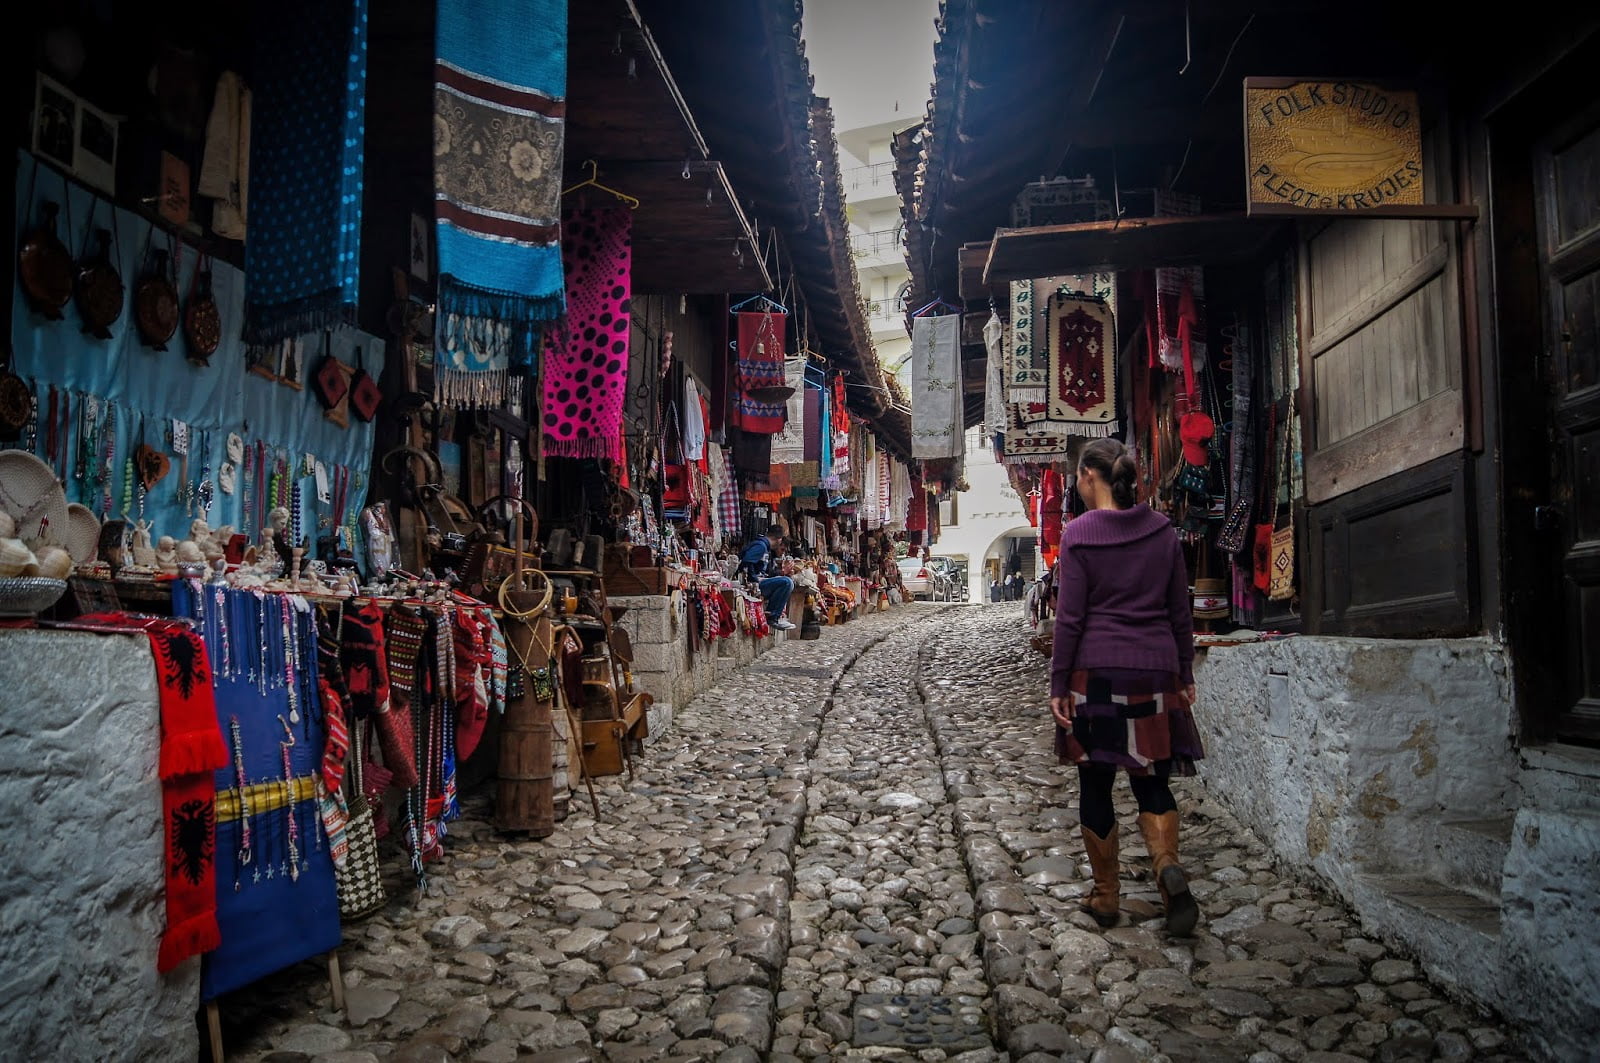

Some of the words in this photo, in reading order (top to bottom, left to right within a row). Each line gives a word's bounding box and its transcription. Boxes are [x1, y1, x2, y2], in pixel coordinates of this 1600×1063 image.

[1260, 84, 1325, 126] FOLK
[1332, 82, 1411, 129] STUDIO
[1337, 160, 1422, 209] KRUJES
